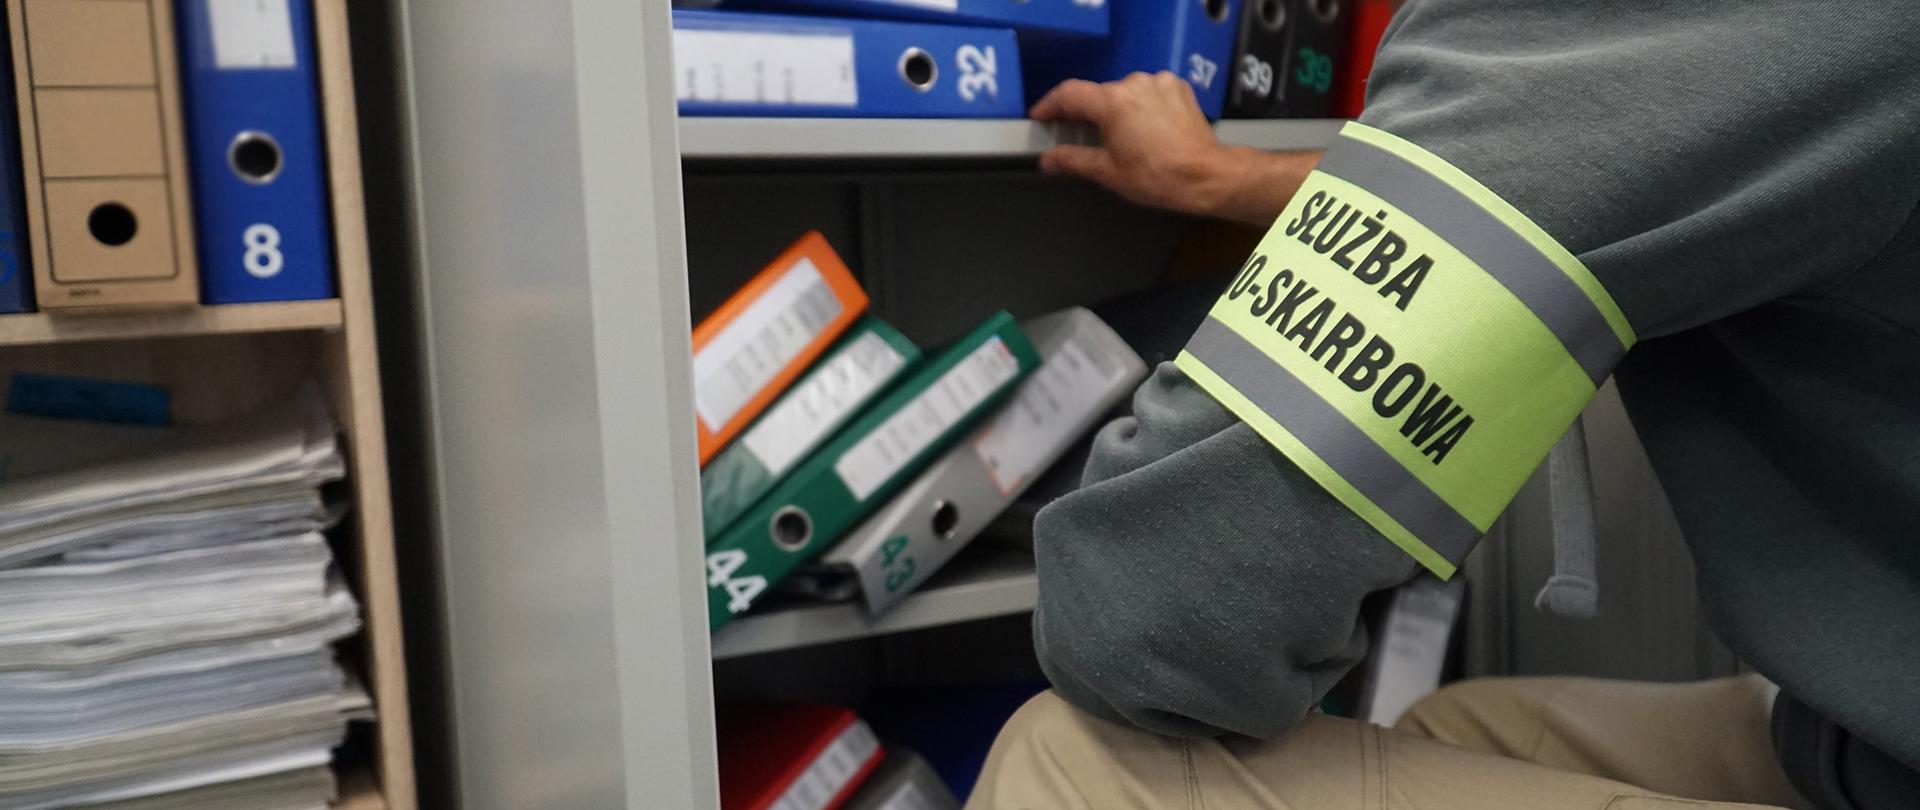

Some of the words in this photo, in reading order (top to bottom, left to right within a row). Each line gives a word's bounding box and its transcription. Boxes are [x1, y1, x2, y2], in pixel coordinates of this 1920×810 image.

[957, 45, 998, 101] 32
[1242, 54, 1273, 97] 39
[1297, 47, 1333, 93] 39
[243, 223, 284, 278] 8
[1285, 190, 1435, 312] SŁUŻBA
[1223, 252, 1475, 465] O-SKARBOWA
[707, 549, 768, 612] 44
[881, 534, 918, 593] 43
